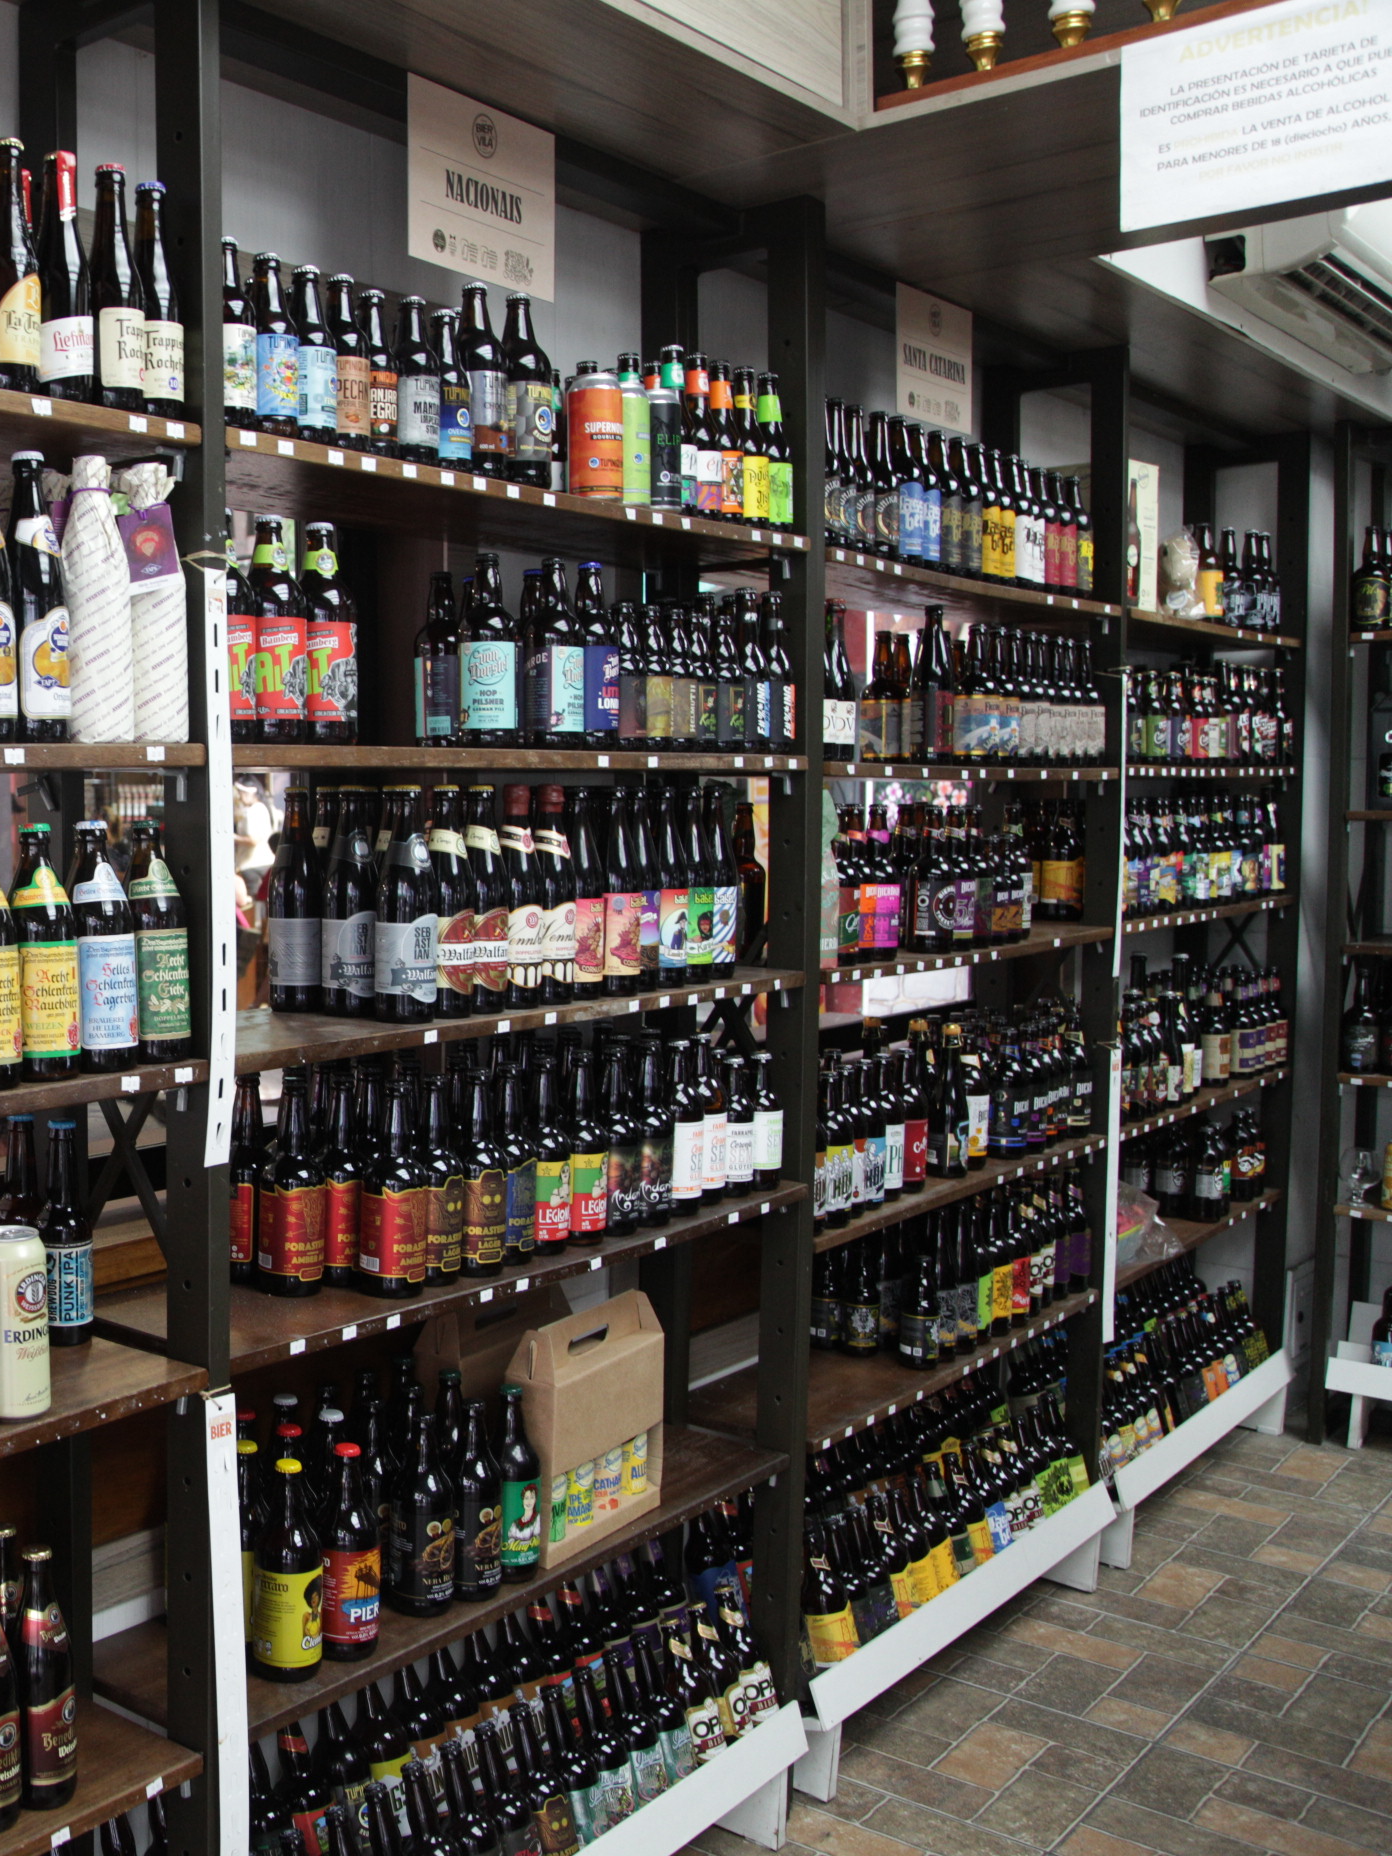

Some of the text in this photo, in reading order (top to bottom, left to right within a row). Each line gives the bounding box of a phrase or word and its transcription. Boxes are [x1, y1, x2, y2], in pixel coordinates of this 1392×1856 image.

[1170, 85, 1185, 97] LA
[1188, 61, 1279, 93] PRESENTACIÓN
[1283, 58, 1299, 69] DE
[1360, 36, 1378, 48] DE
[1140, 57, 1364, 118] IDENTIFICACIÓN ES NECESARIO A QUE
[1170, 68, 1377, 125] COMPRAR BEBIDAS ALCOHÓLICAS
[476, 123, 493, 134] BIER
[1159, 93, 1390, 154] ES LA VENTA DE ALCOHOL
[477, 135, 493, 149] VILA
[1157, 156, 1188, 171] PARA
[1192, 144, 1248, 165] MENORES
[1251, 140, 1267, 151] DE
[1272, 136, 1281, 146] 18
[445, 168, 522, 224] NACIONAIS
[904, 344, 965, 384] SANTA CATARINA
[170, 379, 177, 388] 10
[337, 379, 369, 399] PECAN
[370, 388, 397, 403] ANJAR
[370, 403, 397, 420] EGRO
[262, 634, 298, 646] Bamberg
[414, 927, 430, 938] SEB
[414, 938, 430, 948] AST
[414, 949, 429, 960] IAN
[27, 1022, 63, 1030] WEIZEN
[17, 1271, 46, 1295] ERDINGER
[63, 1251, 74, 1322] PUNK IPA
[49, 1278, 57, 1321] BREWDOG
[211, 1422, 232, 1440] BIER
[351, 1603, 379, 1622] PIER
